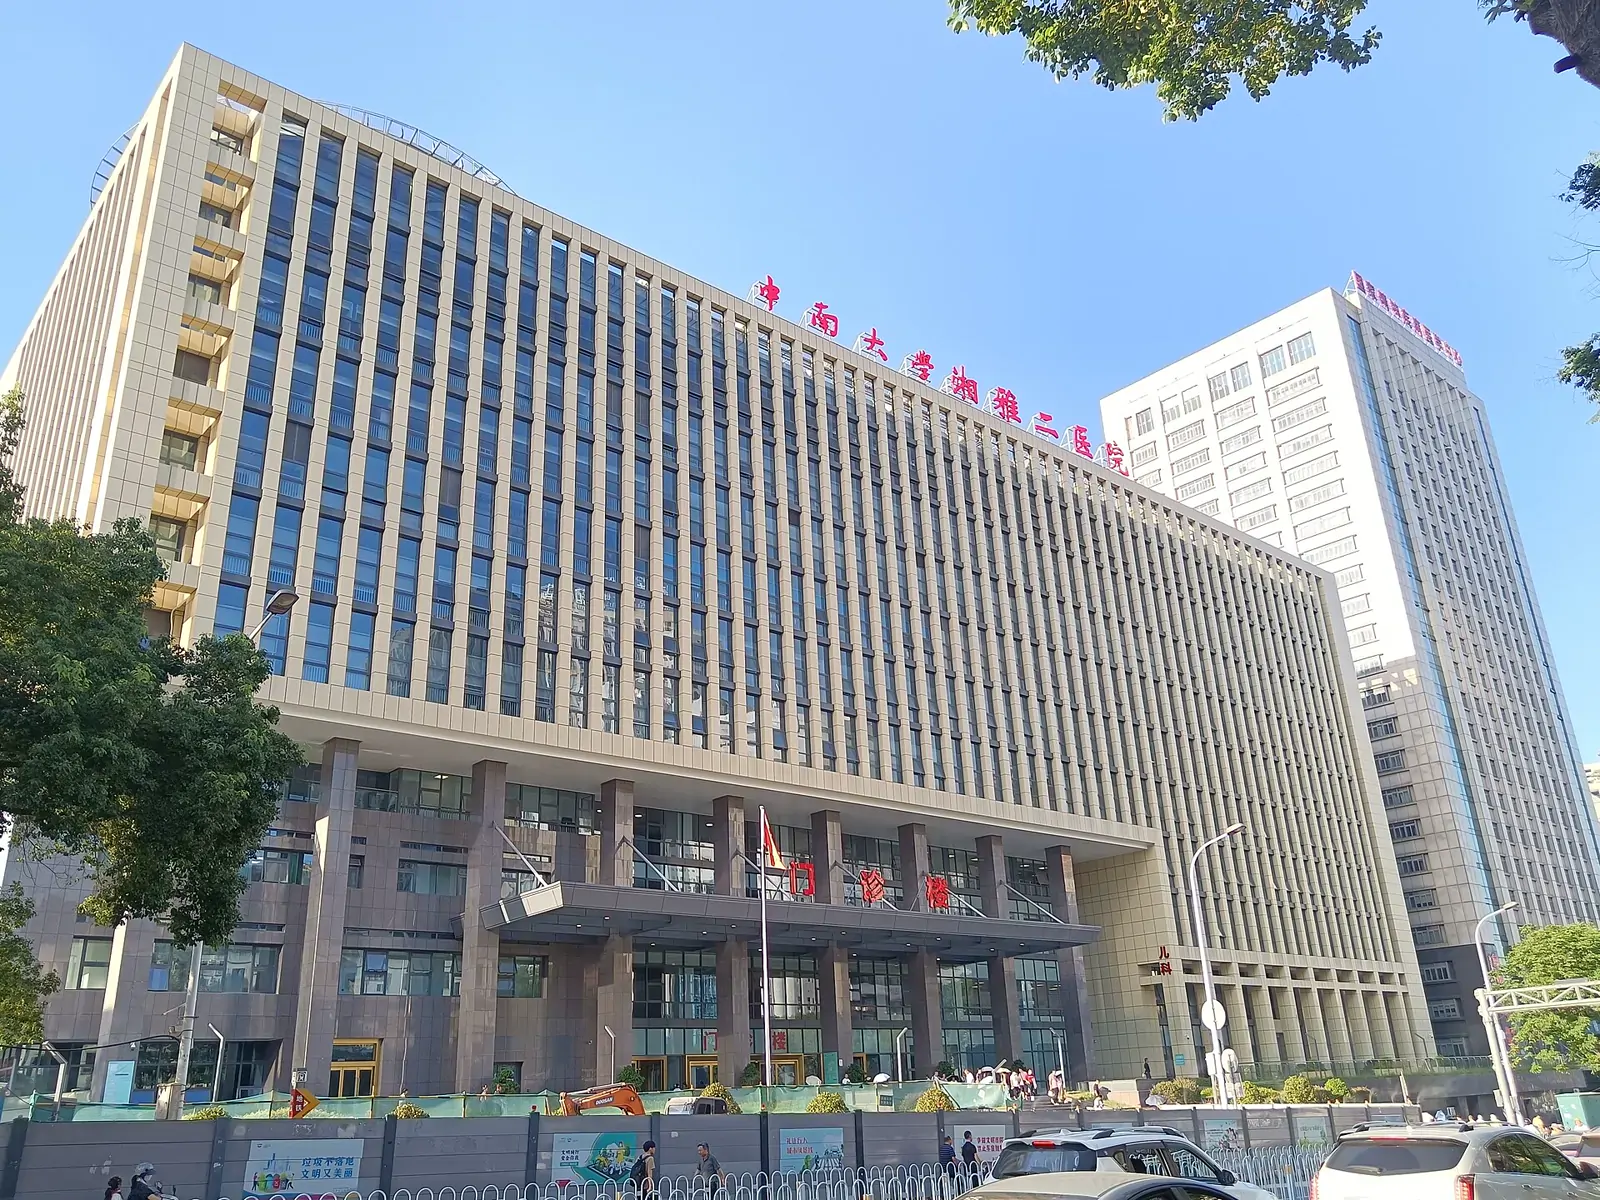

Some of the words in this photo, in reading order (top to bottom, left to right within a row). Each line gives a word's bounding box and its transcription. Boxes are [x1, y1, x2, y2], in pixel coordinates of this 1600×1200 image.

[759, 274, 1129, 477] 中南大学湘雅二医院
[789, 860, 949, 909] 门诊楼
[1159, 945, 1172, 976] 儿科
[703, 1031, 786, 1052] 门楼
[301, 1156, 354, 1167] 垃圾不落地
[301, 1168, 353, 1179] 文明又美丽
